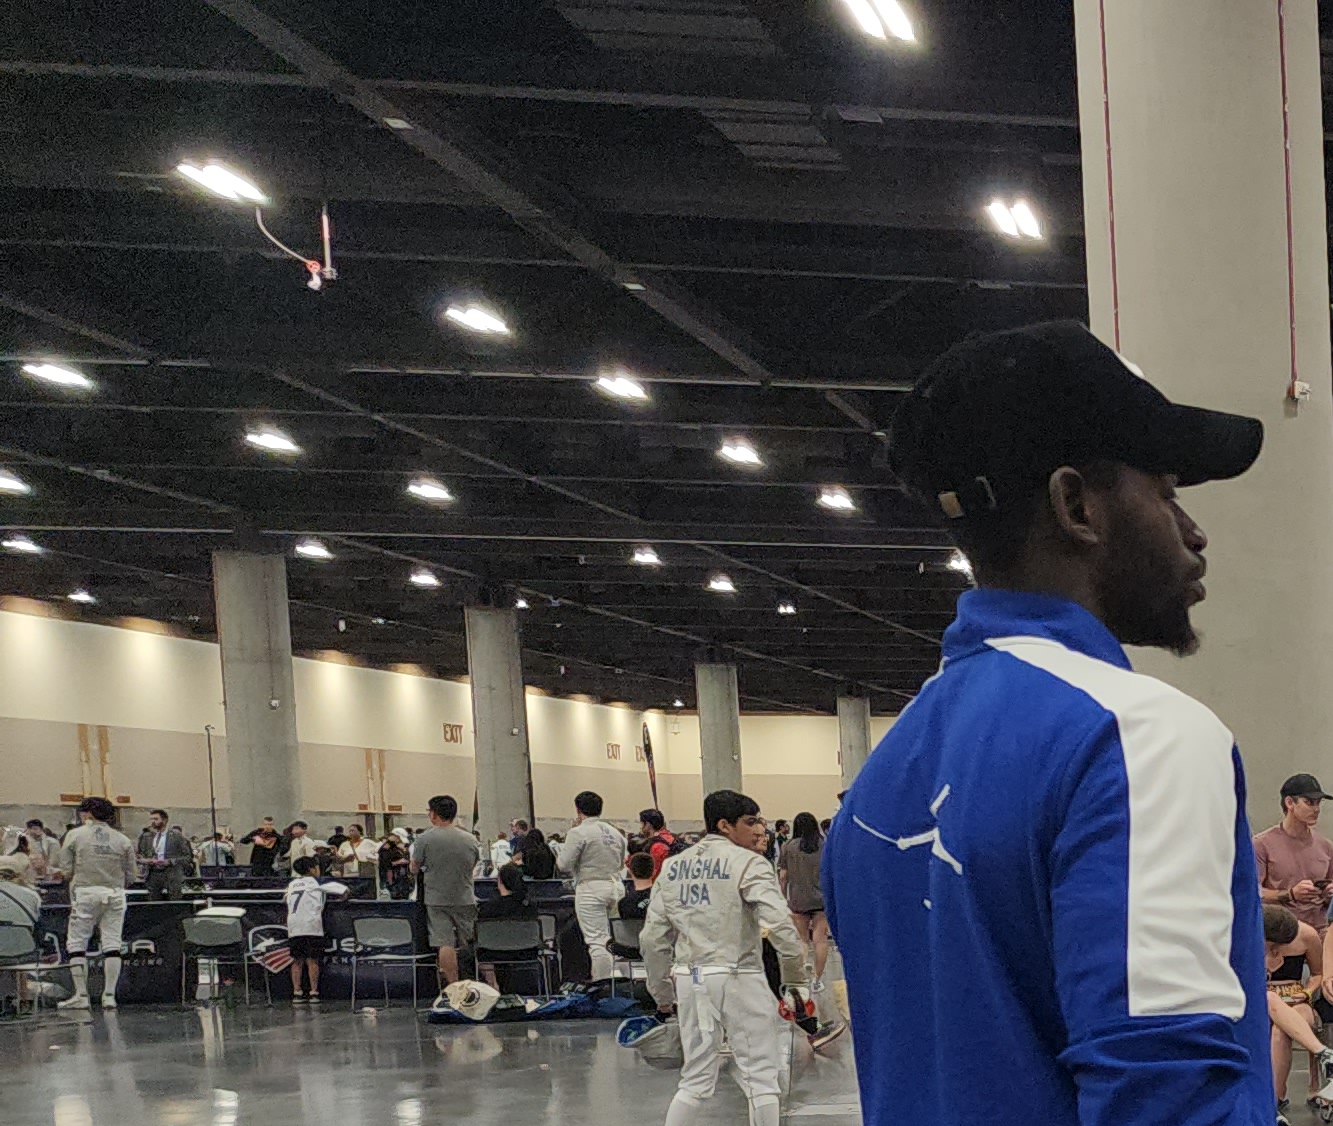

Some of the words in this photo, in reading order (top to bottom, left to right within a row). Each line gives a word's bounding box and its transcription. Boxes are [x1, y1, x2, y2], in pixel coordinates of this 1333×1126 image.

[443, 722, 463, 744] EXIT
[667, 857, 731, 881] SINGHAL
[290, 890, 304, 914] 7
[680, 882, 711, 906] USA
